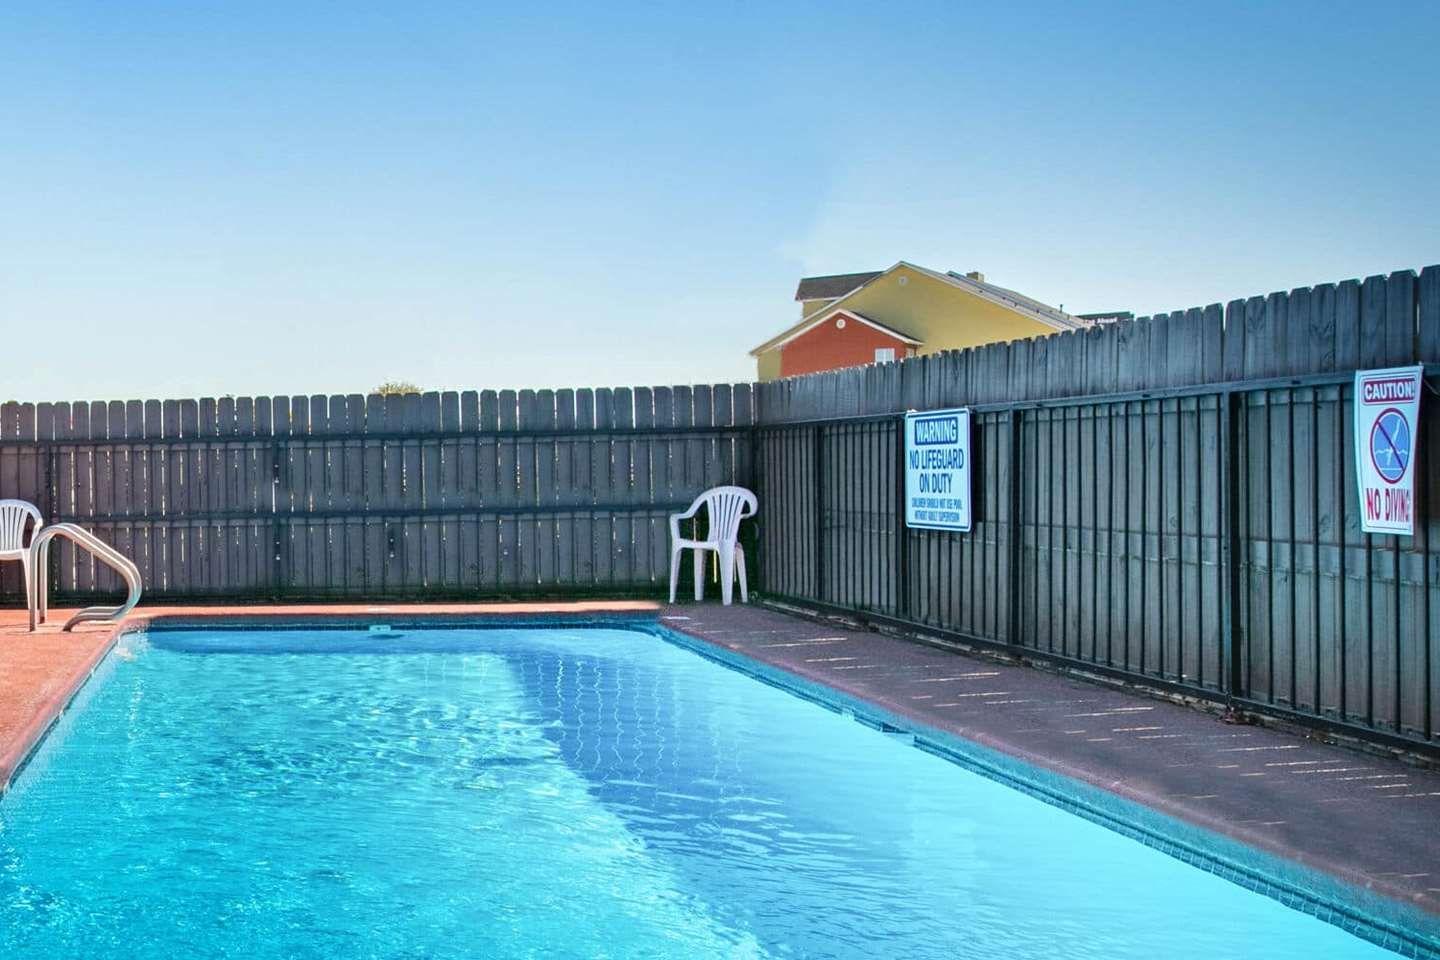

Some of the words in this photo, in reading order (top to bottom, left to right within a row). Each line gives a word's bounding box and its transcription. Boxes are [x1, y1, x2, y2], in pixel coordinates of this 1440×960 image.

[1364, 381, 1415, 400] CAUTION!
[916, 418, 958, 443] WARNING
[910, 449, 919, 470] NO
[921, 448, 964, 470] LIFEGUARD
[919, 473, 930, 493] ON
[932, 473, 952, 494] DUTY
[1366, 487, 1381, 521] NO
